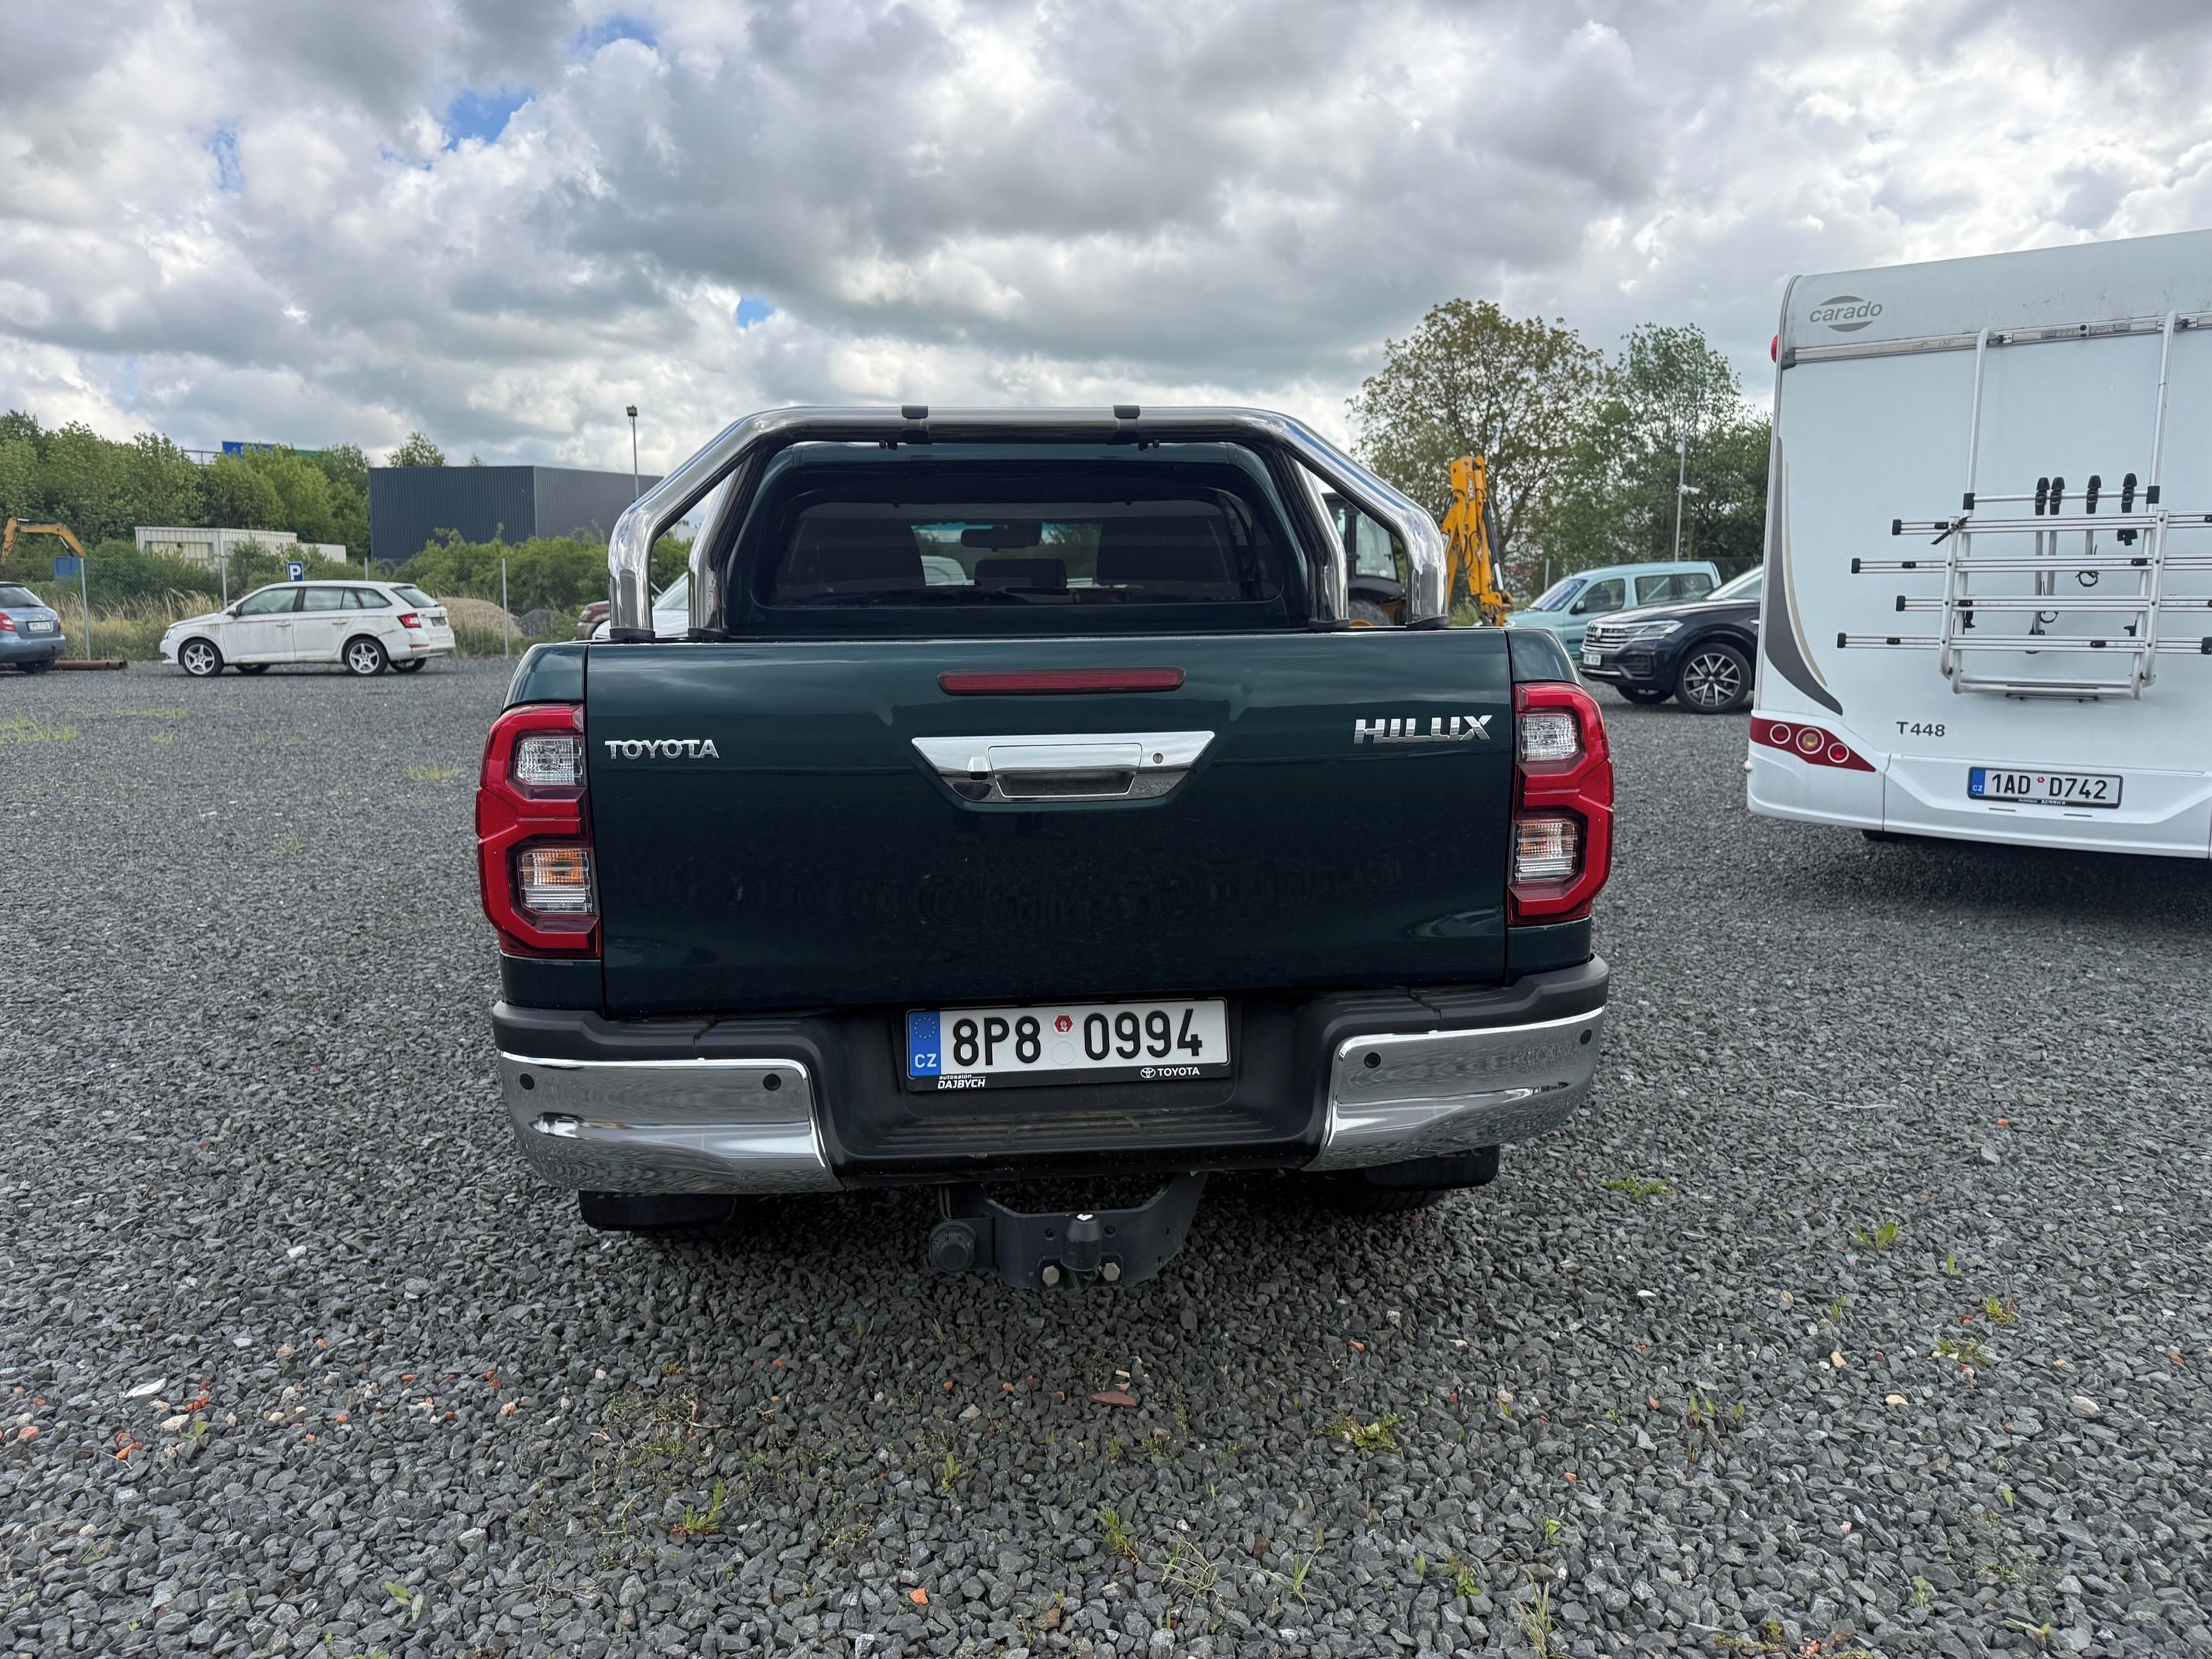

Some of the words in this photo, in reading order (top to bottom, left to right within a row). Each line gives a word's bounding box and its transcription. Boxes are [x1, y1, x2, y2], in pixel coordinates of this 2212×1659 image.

[1809, 301, 1883, 322] carado
[289, 564, 301, 581] P
[1353, 715, 1493, 744] HILUX
[604, 739, 720, 760] TOYOTA
[1991, 774, 2032, 795] 1AD
[2049, 777, 2108, 800] D742
[953, 1016, 1042, 1067] 8P8
[1084, 1008, 1203, 1062] 0994
[915, 1053, 937, 1069] CZ
[1157, 1066, 1200, 1077] TOYOTA
[937, 1078, 986, 1090] DAJBYCH
